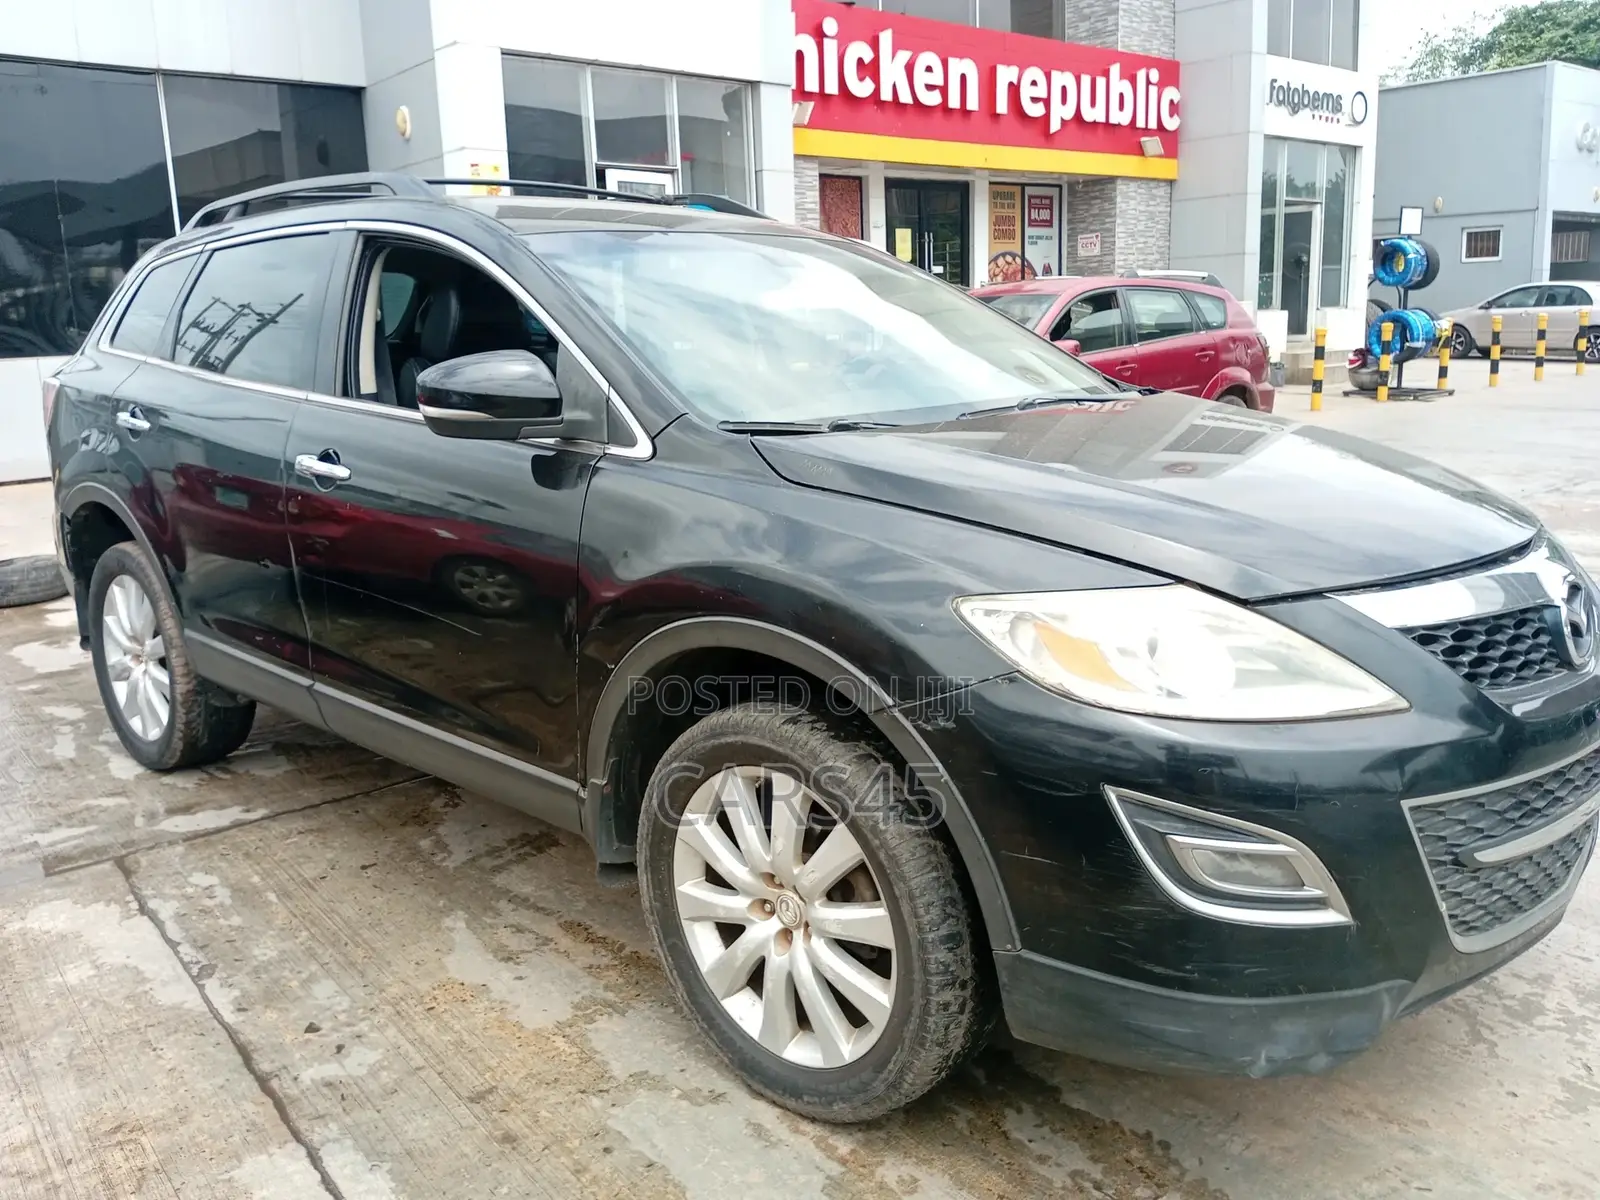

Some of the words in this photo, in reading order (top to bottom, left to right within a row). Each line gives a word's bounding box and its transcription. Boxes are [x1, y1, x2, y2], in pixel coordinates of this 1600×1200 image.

[995, 62, 1181, 135] republic
[993, 215, 1016, 227] JUMBO
[993, 228, 1016, 240] COMBO
